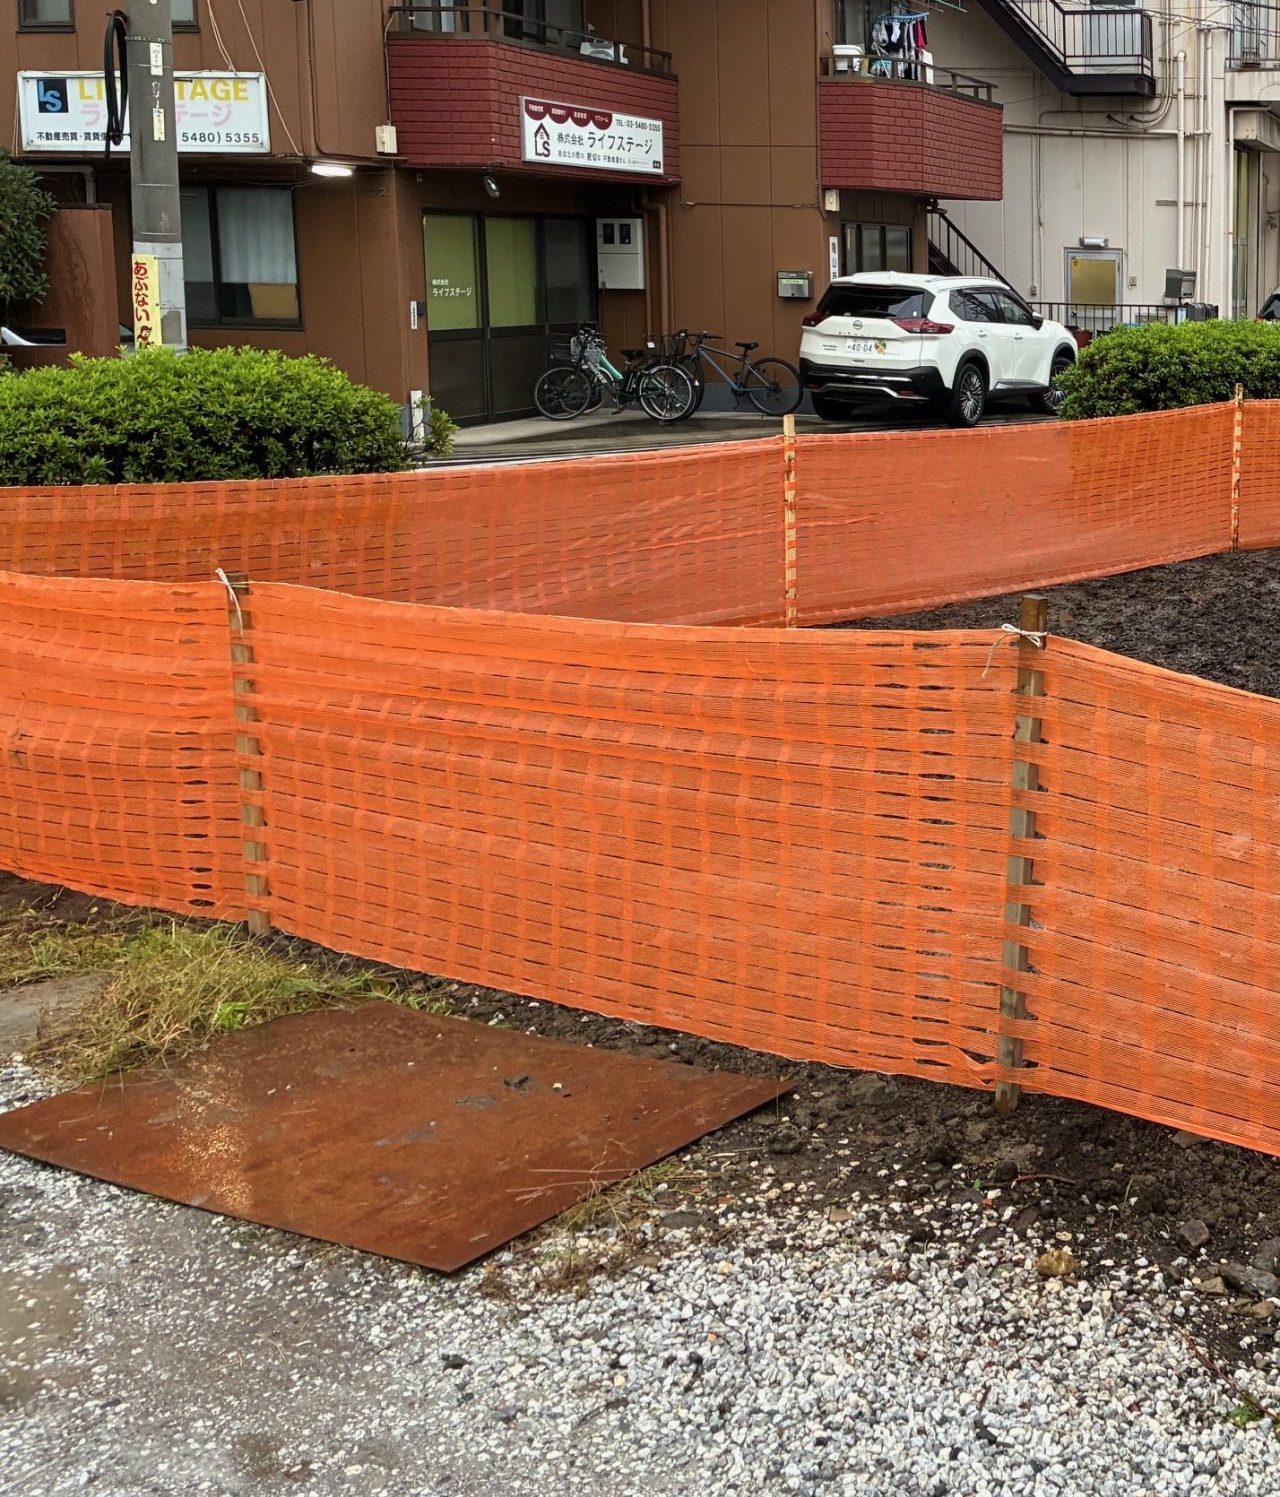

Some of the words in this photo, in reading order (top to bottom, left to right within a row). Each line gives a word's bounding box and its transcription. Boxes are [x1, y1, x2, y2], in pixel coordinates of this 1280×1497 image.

[587, 131, 653, 155] ライフステージ
[134, 260, 151, 322] あぶない
[432, 287, 472, 297] ライフステージ
